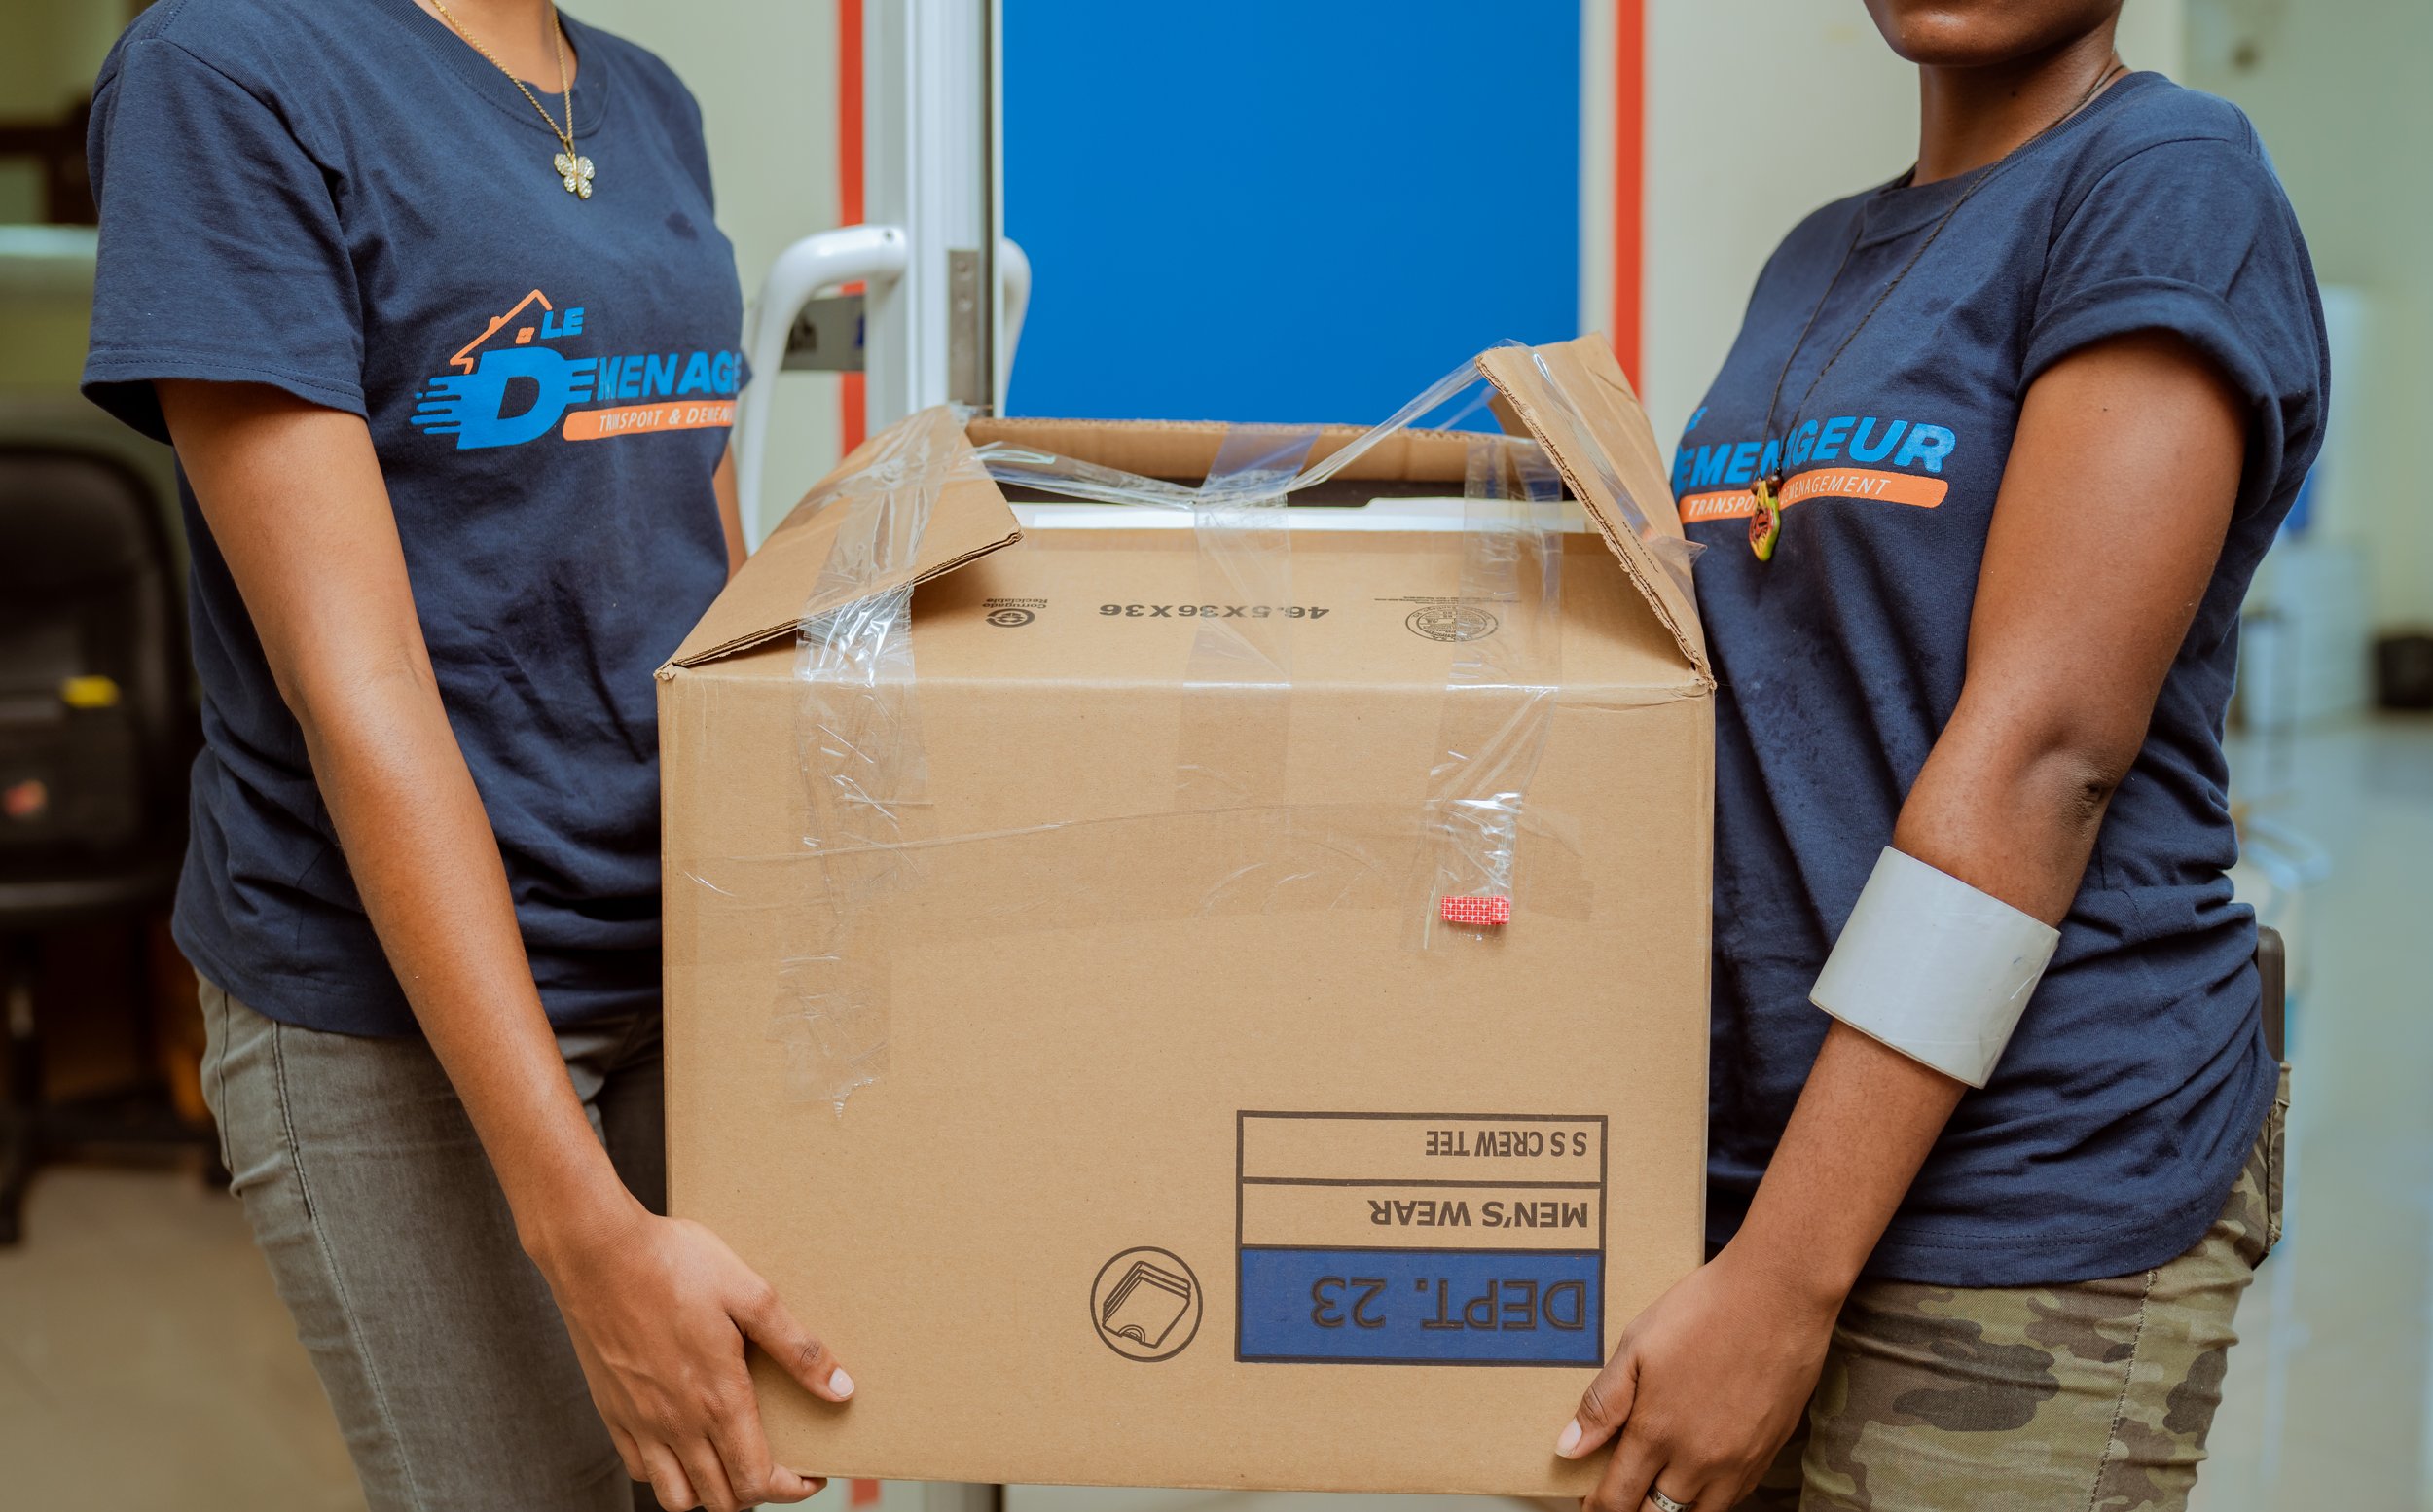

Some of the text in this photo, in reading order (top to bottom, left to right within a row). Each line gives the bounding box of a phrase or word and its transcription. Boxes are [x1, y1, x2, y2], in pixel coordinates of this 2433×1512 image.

[540, 307, 584, 339] LE
[668, 407, 682, 425] &
[1689, 494, 1756, 517] TRANSPO
[1425, 1130, 1587, 1157] S S CREW TEE
[1367, 1200, 1588, 1228] MEN'S WEAR
[1310, 1275, 1587, 1332] DEPT. 23
